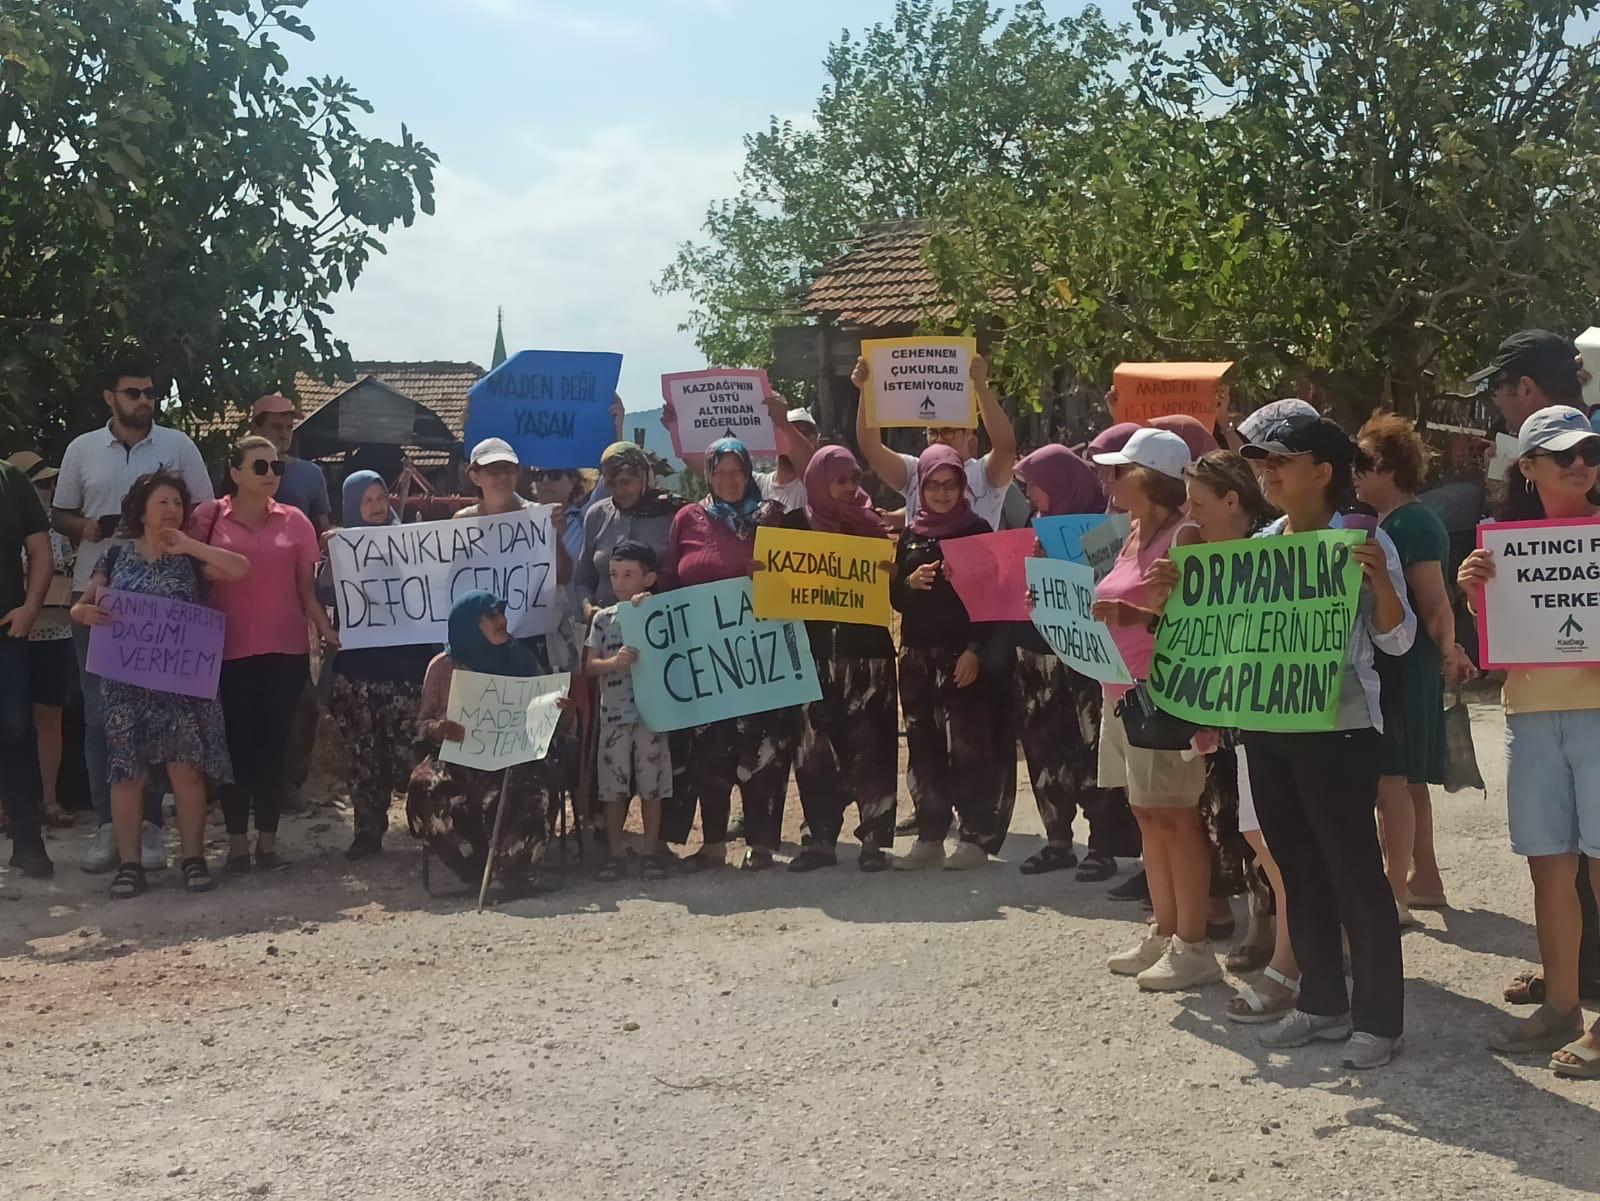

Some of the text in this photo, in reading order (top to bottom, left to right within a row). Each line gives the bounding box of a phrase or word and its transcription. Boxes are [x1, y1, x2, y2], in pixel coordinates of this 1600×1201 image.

[892, 348, 957, 359] CEHENNEM
[891, 365, 958, 377] ÇUKURLARI
[487, 372, 553, 401] MADEN
[682, 379, 754, 394] KAZDAĞI'NIN
[709, 392, 740, 403] ÜSTÜ
[694, 416, 762, 429] DEĞERLİDİR
[698, 404, 754, 416] ALTINDAN
[514, 409, 576, 439] YAŞAM
[338, 518, 548, 572] YANIKLAR'DAN
[1503, 538, 1583, 557] ALTINCI
[767, 549, 877, 584] KAZDAĞLARI
[1182, 541, 1349, 607] ORMANLAR
[340, 575, 448, 628] DEFOL
[791, 585, 865, 609] HEPİMİZİN
[1531, 592, 1600, 609] TERKE
[644, 590, 768, 650] GİT LA
[1155, 607, 1308, 657] MADENCİLERİN
[118, 646, 217, 677] VERMEM
